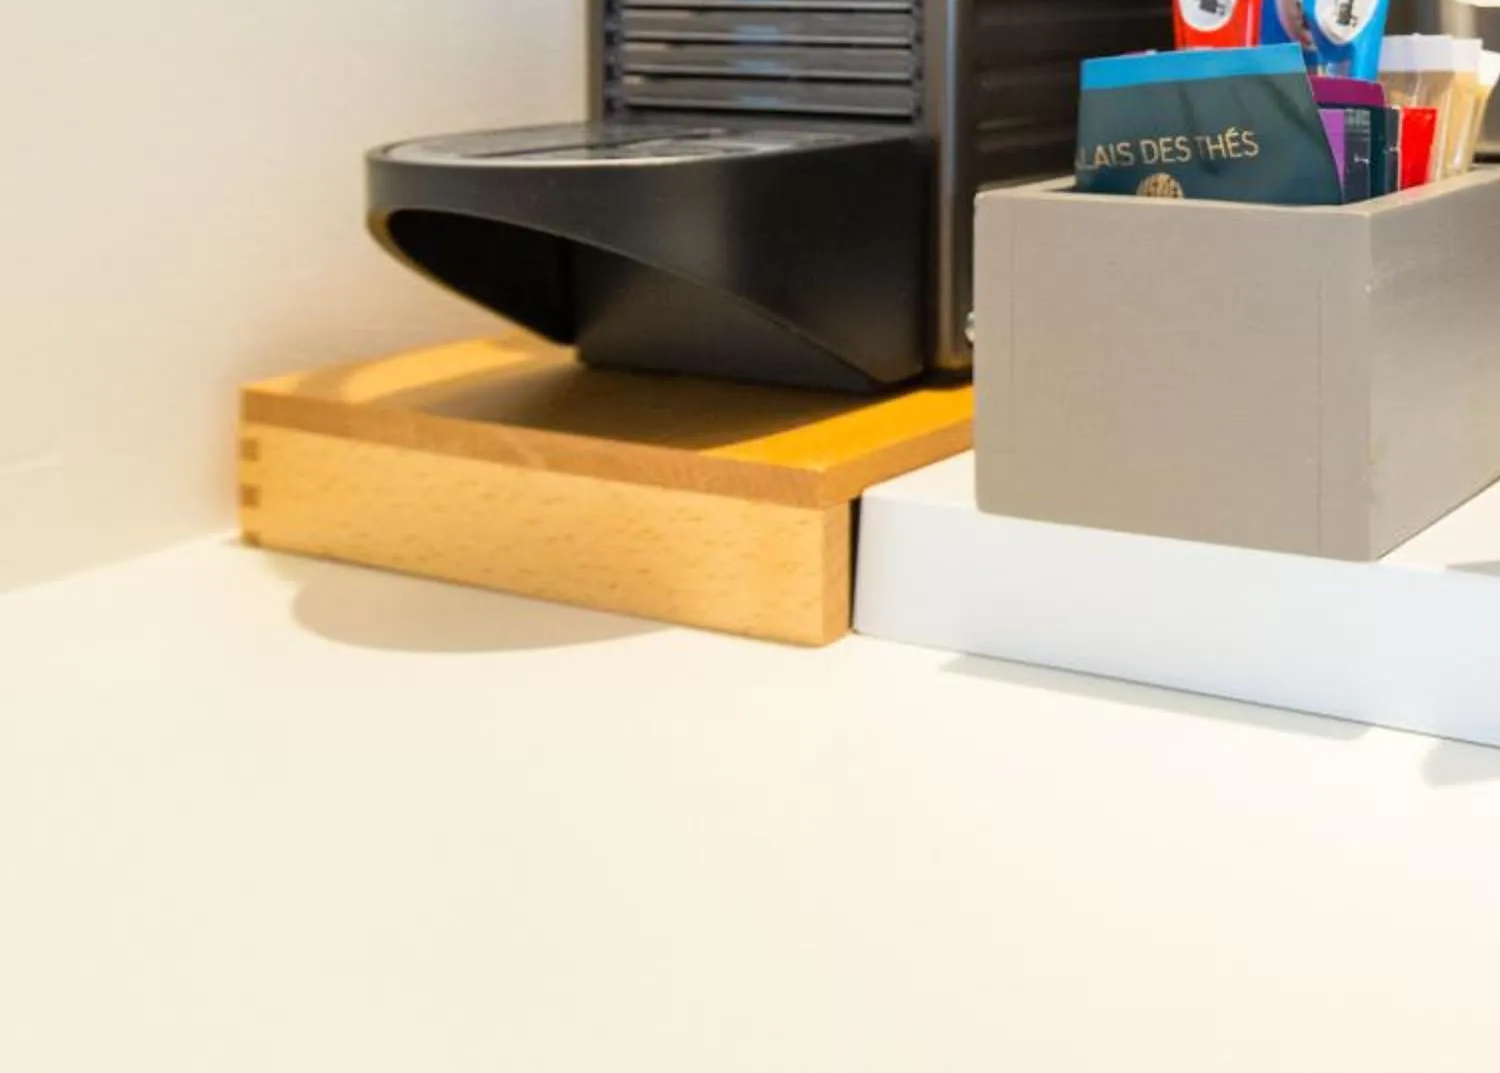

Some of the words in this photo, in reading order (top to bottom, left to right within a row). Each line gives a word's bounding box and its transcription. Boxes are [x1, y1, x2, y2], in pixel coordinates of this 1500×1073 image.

[1076, 141, 1134, 170] LAIS
[1139, 135, 1192, 165] DES
[1194, 126, 1260, 160] THÉS
